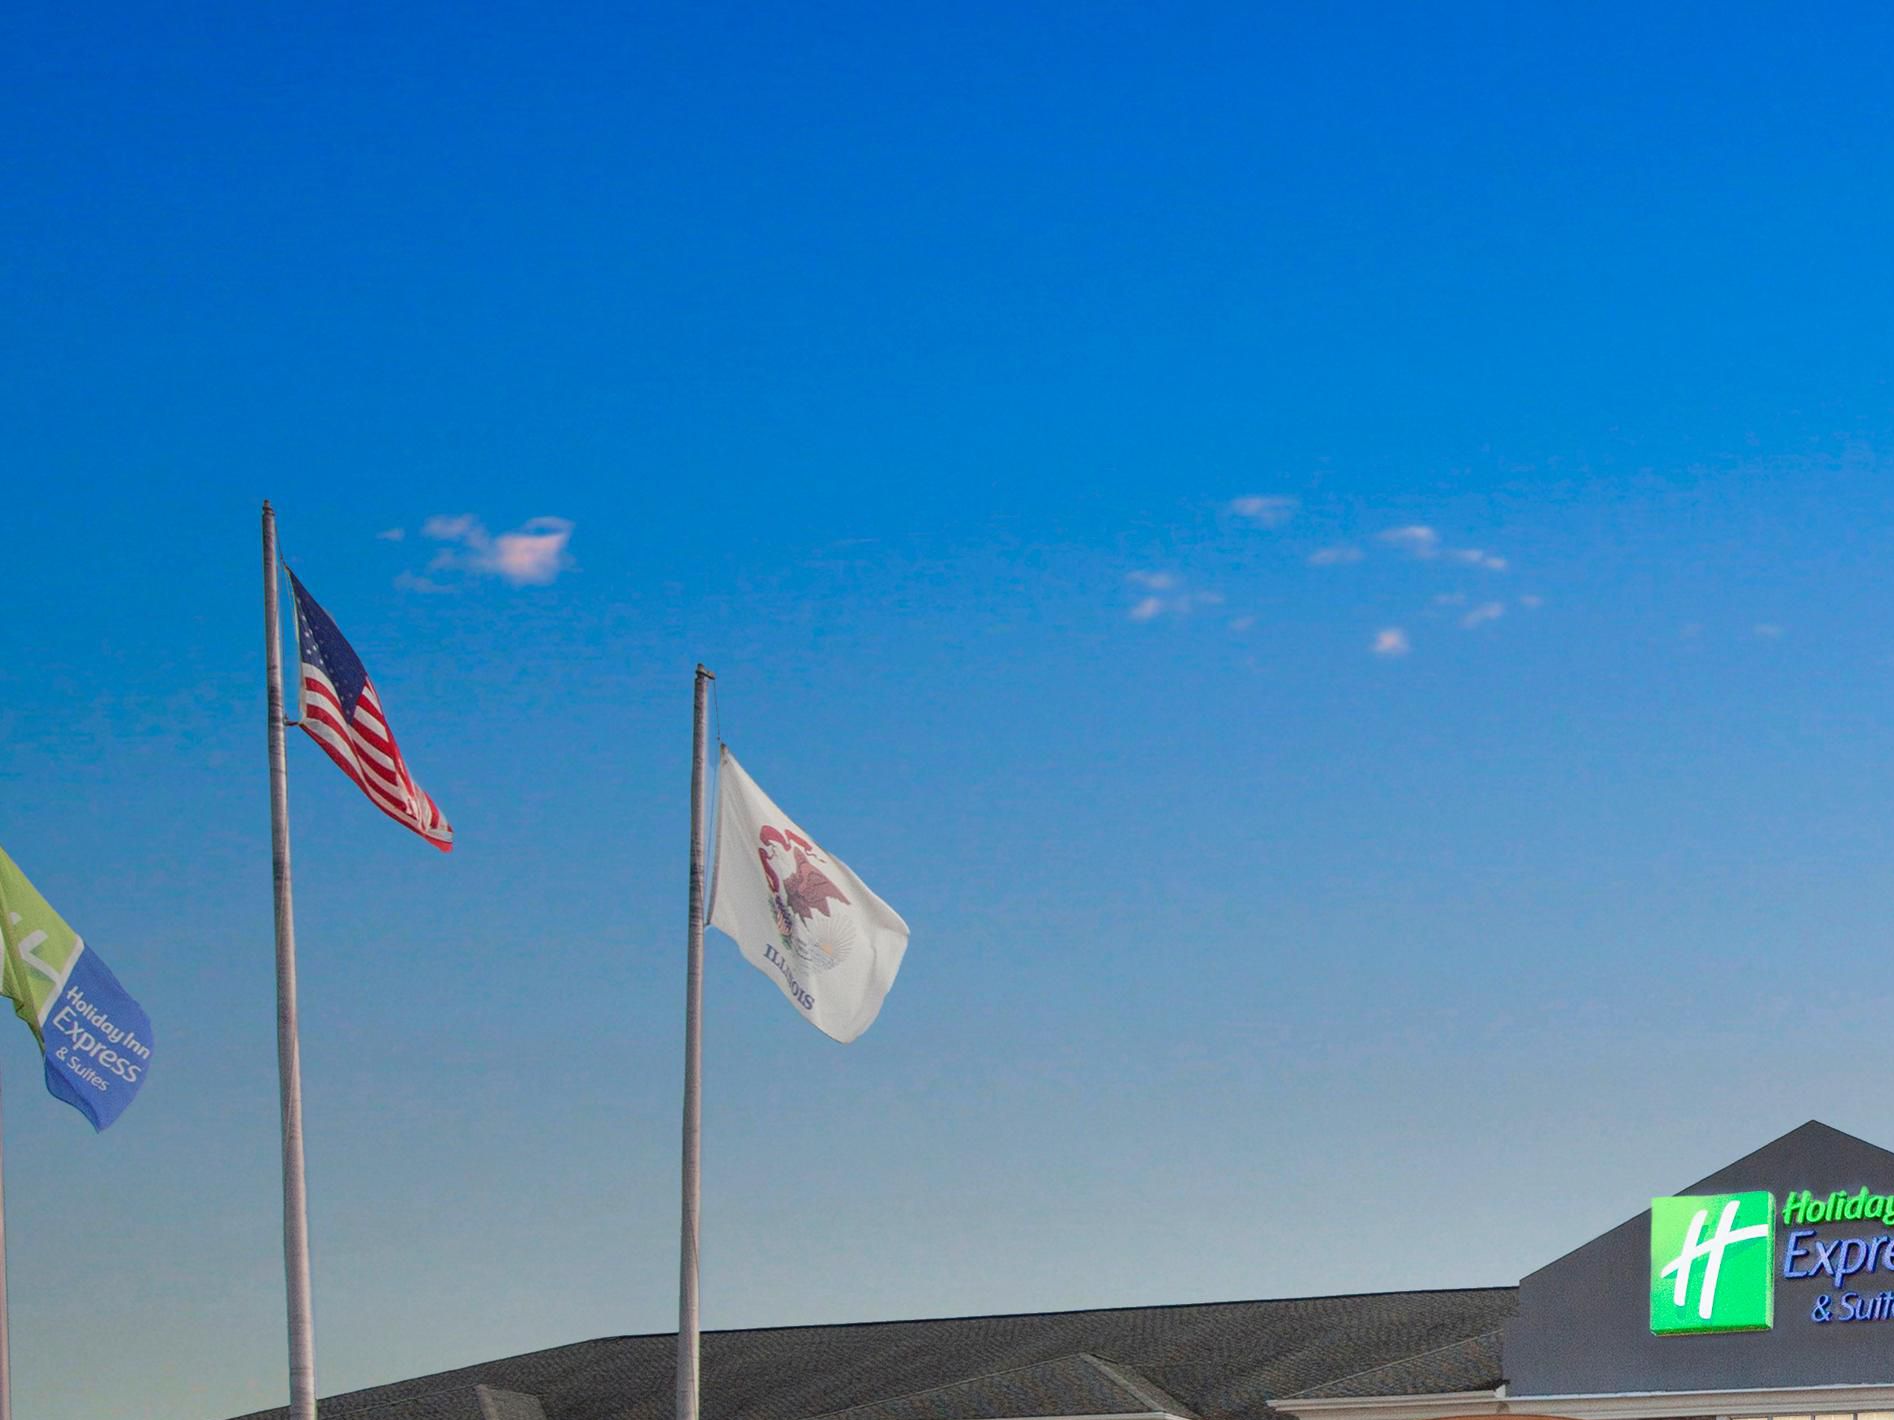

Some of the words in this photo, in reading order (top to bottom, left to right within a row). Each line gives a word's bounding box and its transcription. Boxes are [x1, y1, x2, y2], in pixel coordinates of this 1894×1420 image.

[763, 943, 815, 1010] ILLINOIS
[52, 1006, 142, 1083] Express
[66, 985, 125, 1043] Holiday
[123, 1032, 151, 1060] Inn
[55, 1046, 69, 1061] &
[66, 1056, 110, 1091] Suites
[1810, 1293, 1834, 1324] &
